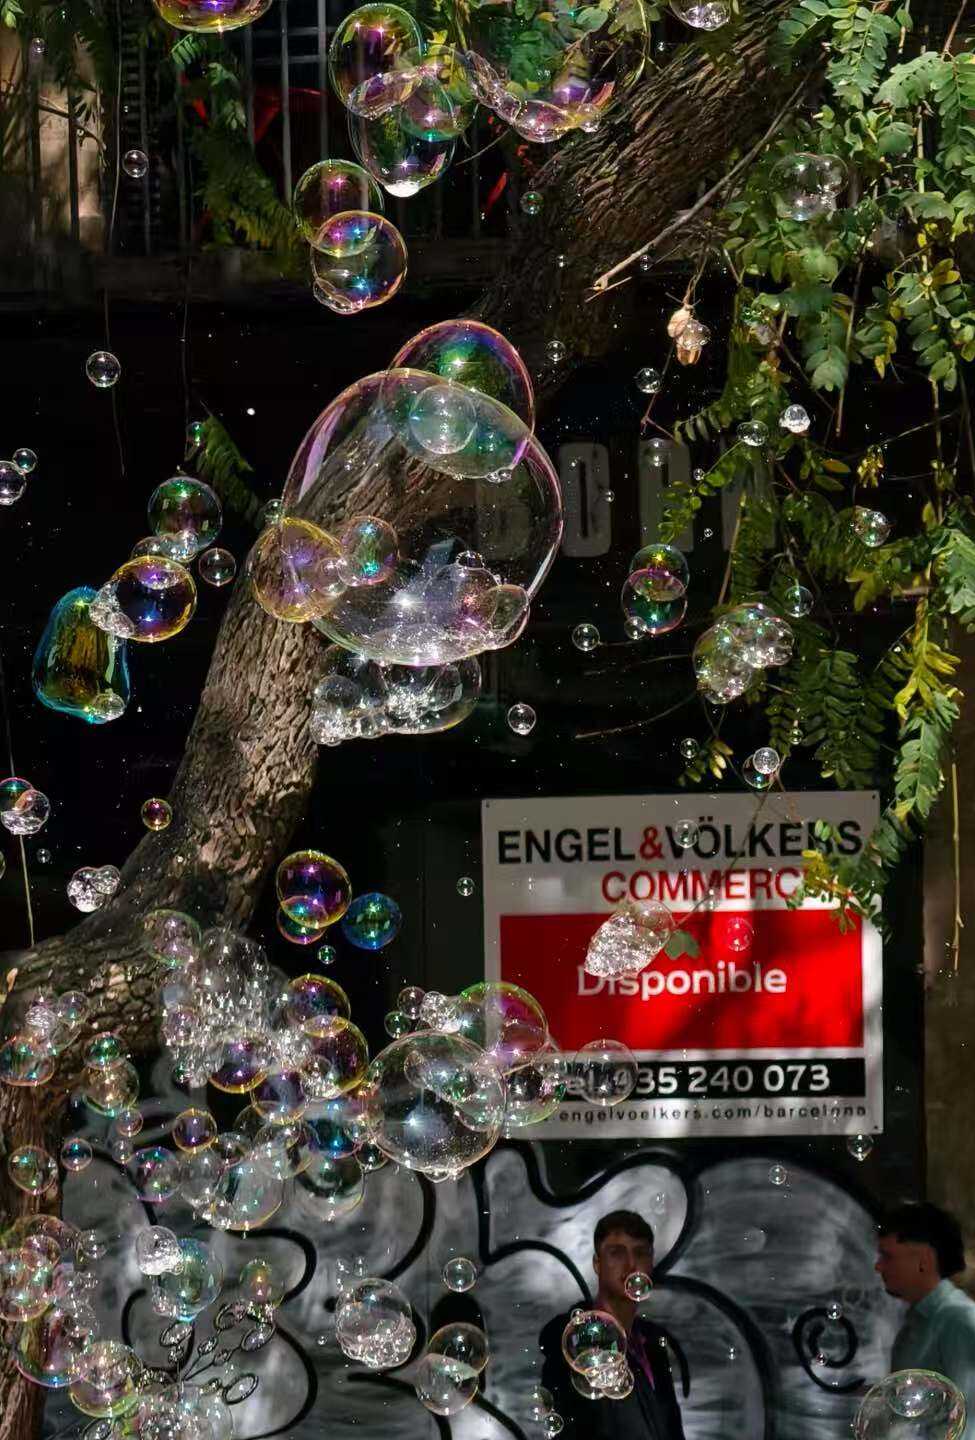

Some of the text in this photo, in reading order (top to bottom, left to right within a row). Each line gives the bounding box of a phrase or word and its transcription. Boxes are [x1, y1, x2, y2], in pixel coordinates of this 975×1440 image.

[602, 867, 806, 903] COMMERC
[577, 961, 787, 1000] Disponible
[688, 1066, 754, 1093] 240
[763, 1064, 831, 1092] 073
